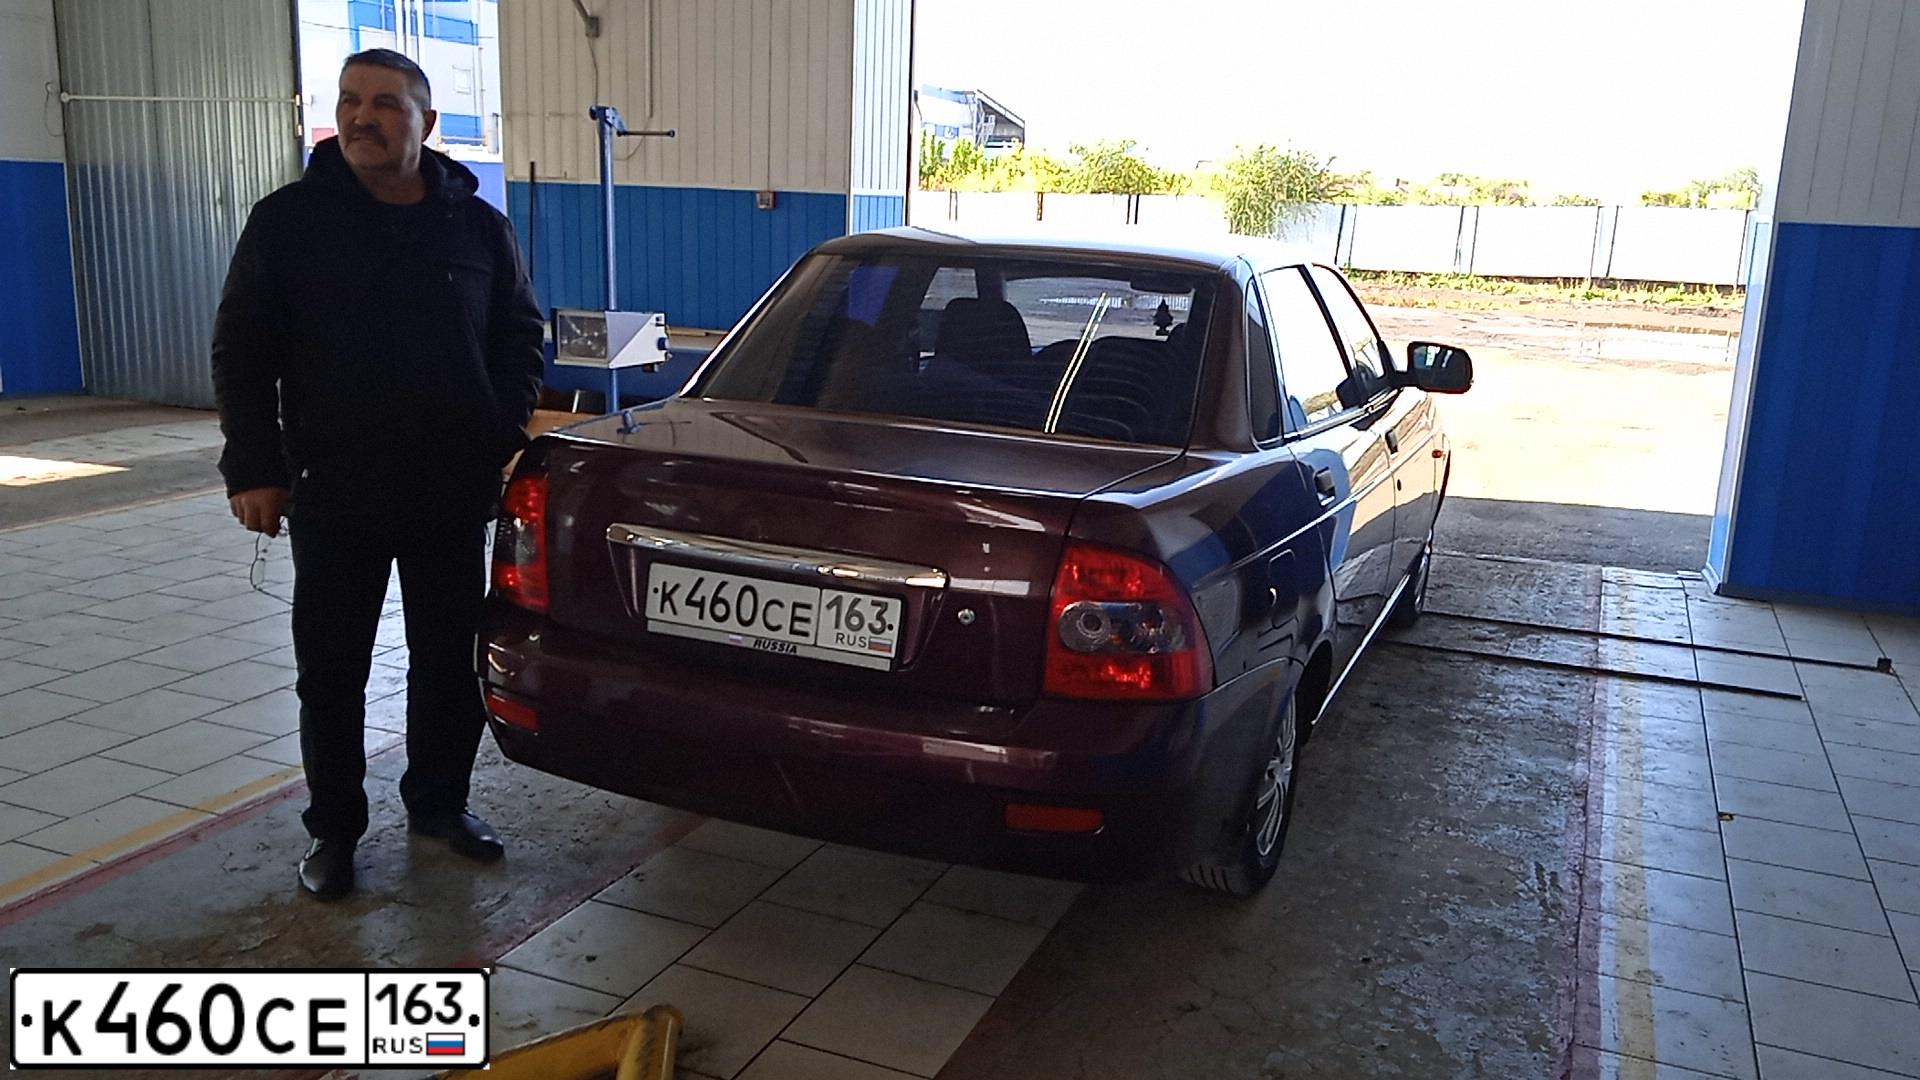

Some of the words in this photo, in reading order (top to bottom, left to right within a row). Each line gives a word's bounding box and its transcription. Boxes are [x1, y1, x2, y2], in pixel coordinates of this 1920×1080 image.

[660, 577, 813, 638] K460CE
[826, 595, 889, 636] 163
[753, 638, 798, 655] RUSSIA
[835, 632, 867, 649] RUS
